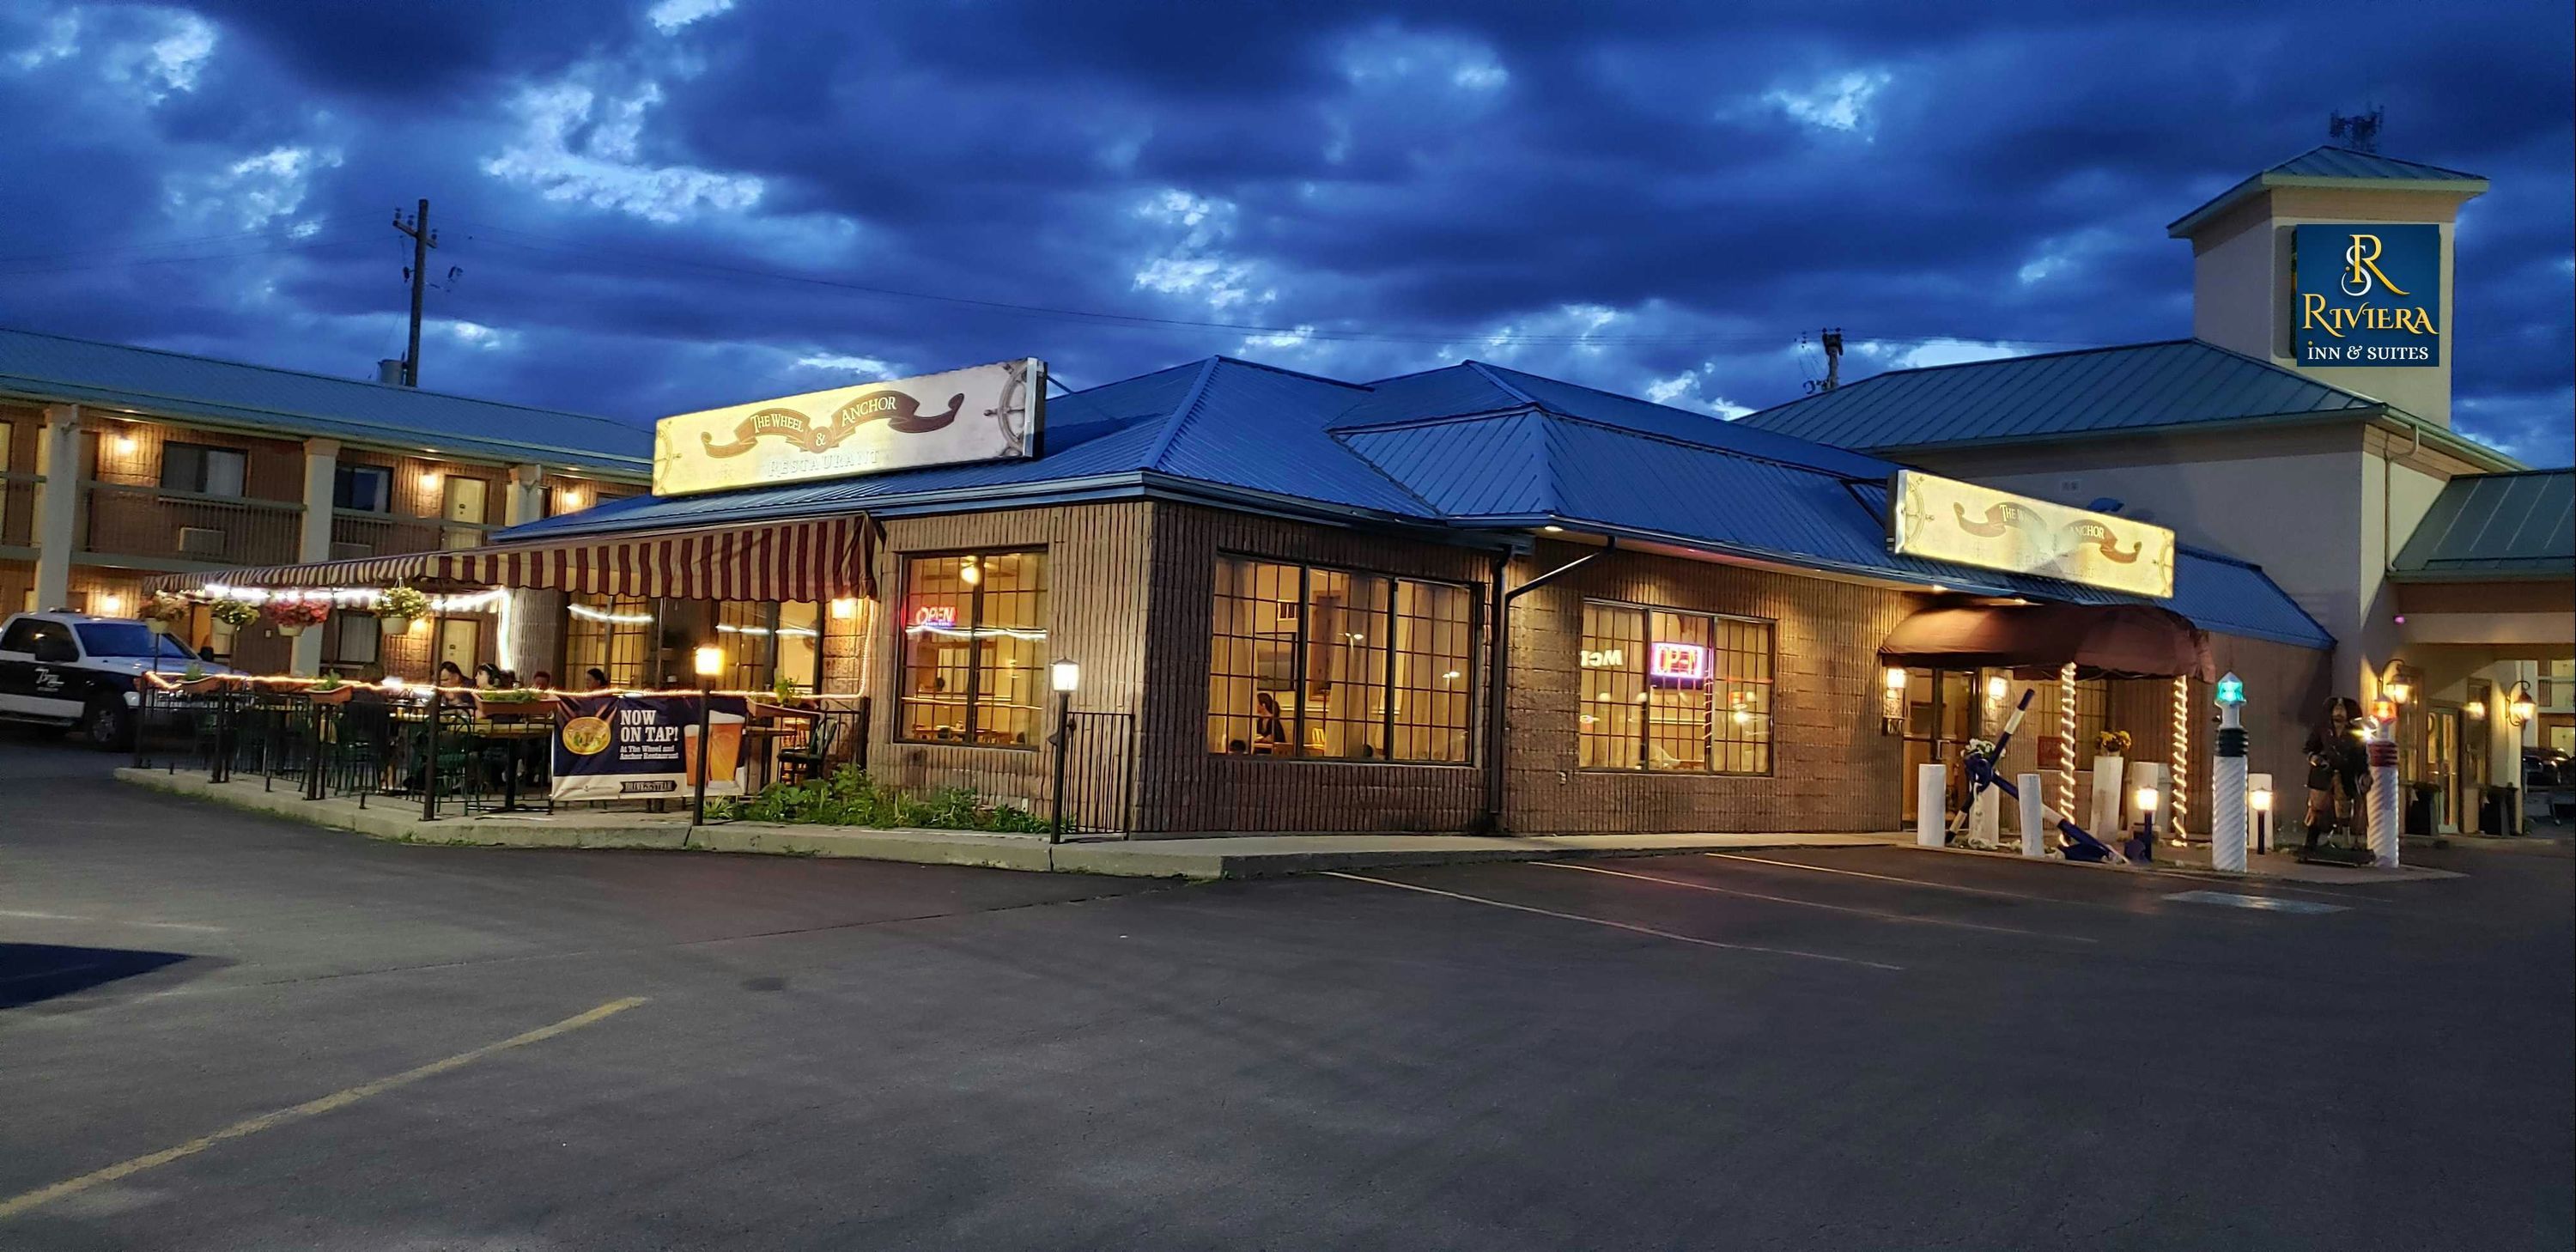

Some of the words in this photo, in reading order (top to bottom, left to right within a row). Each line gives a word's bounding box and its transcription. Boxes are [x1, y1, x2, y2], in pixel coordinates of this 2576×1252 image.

[2347, 345, 2363, 360] &
[2366, 346, 2429, 360] SUITES
[816, 432, 826, 447] &
[841, 396, 897, 428] ANCHOR
[915, 605, 957, 625] OPEN
[1658, 646, 1698, 675] OPEN
[620, 709, 657, 726] NOW
[620, 726, 641, 743] ON
[645, 726, 678, 742] TAP!
